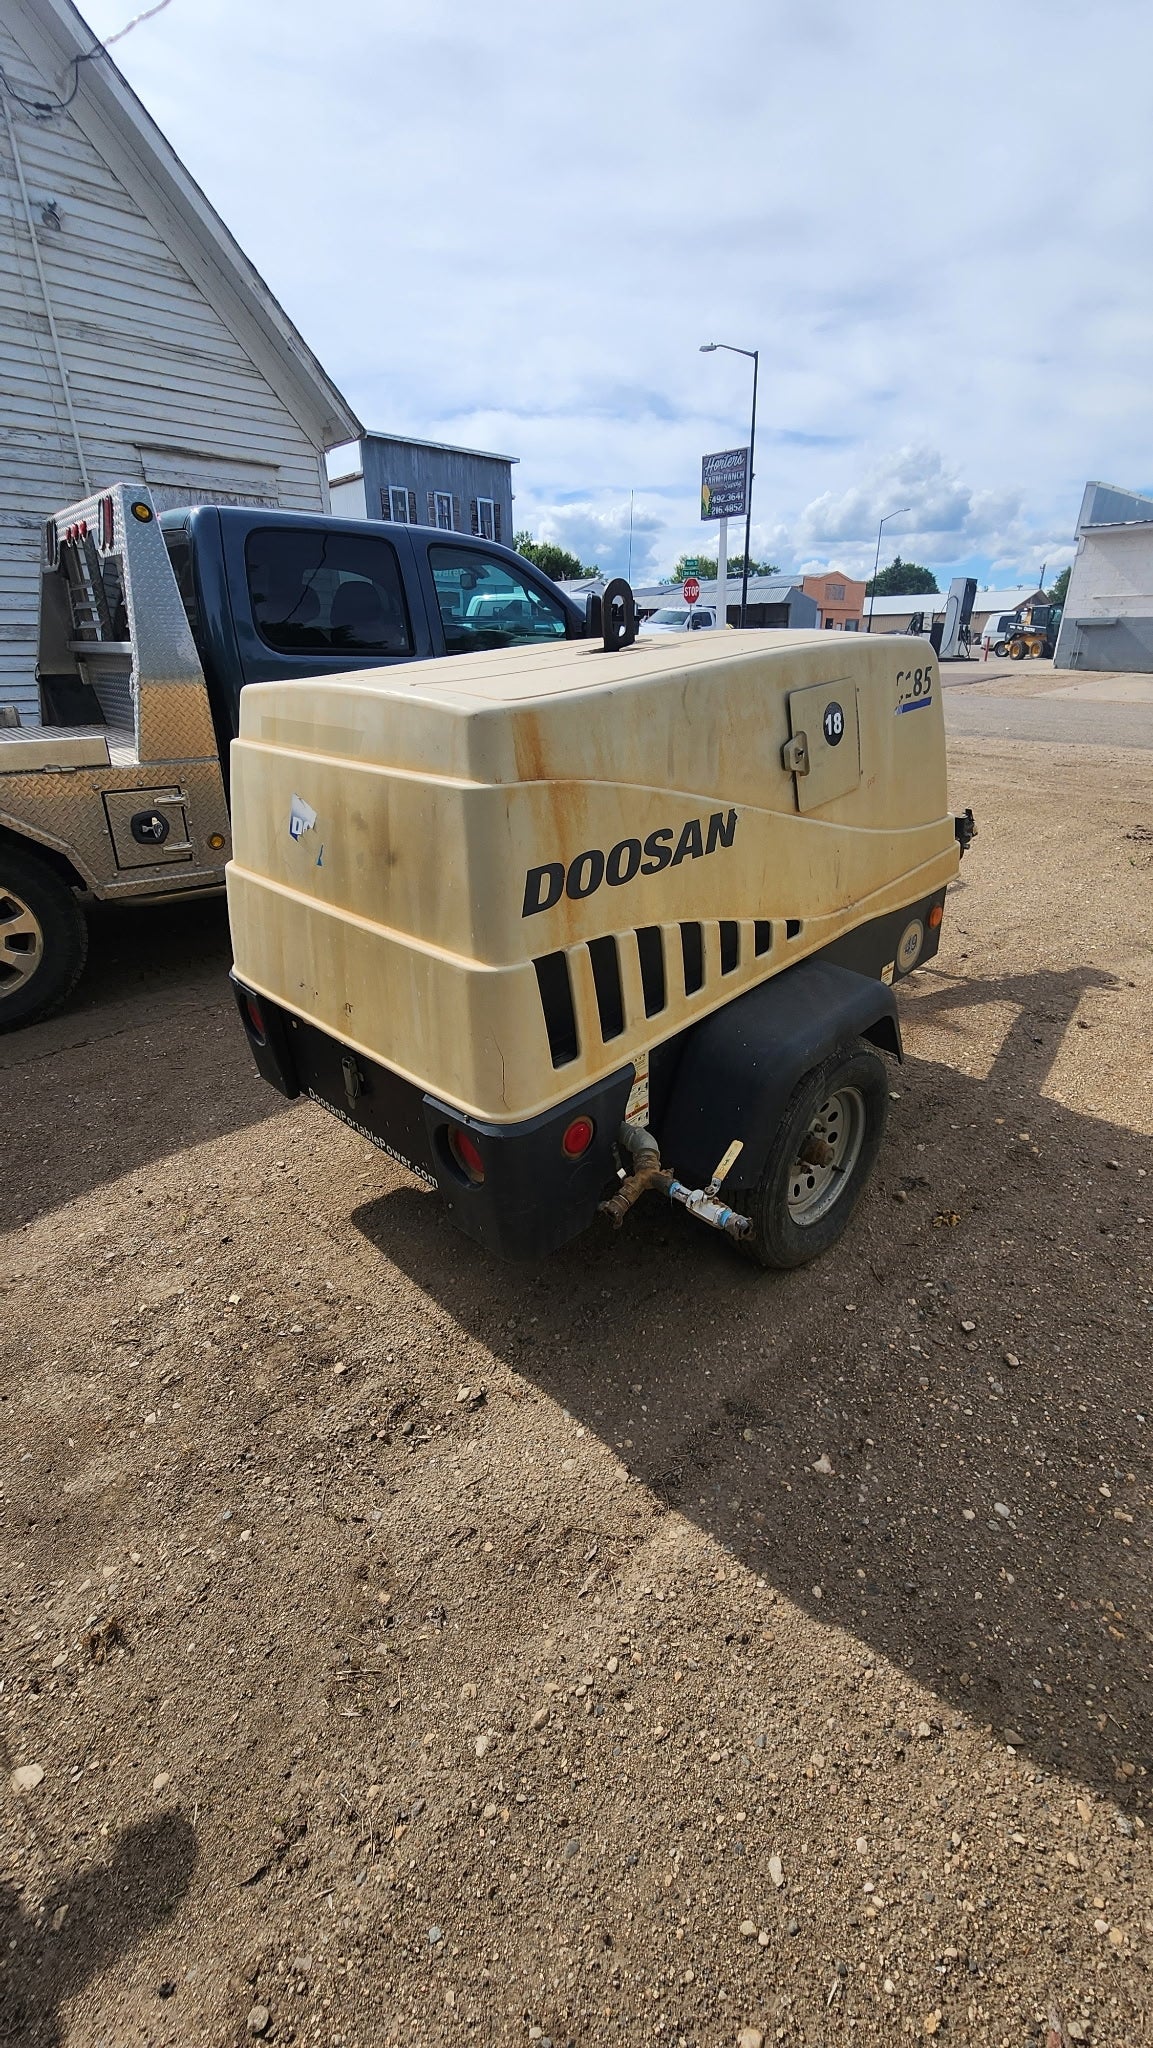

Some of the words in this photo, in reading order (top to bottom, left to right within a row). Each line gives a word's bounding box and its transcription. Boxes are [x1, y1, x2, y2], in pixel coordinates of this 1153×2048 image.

[705, 451, 744, 476] Horter's
[704, 474, 720, 486] FARM
[724, 470, 745, 482] RANCH
[684, 586, 699, 597] STOP
[897, 666, 932, 704] 85
[825, 712, 842, 736] 18
[522, 808, 738, 919] DOOSAN
[308, 1087, 439, 1189] DoosanPortablePower.com
